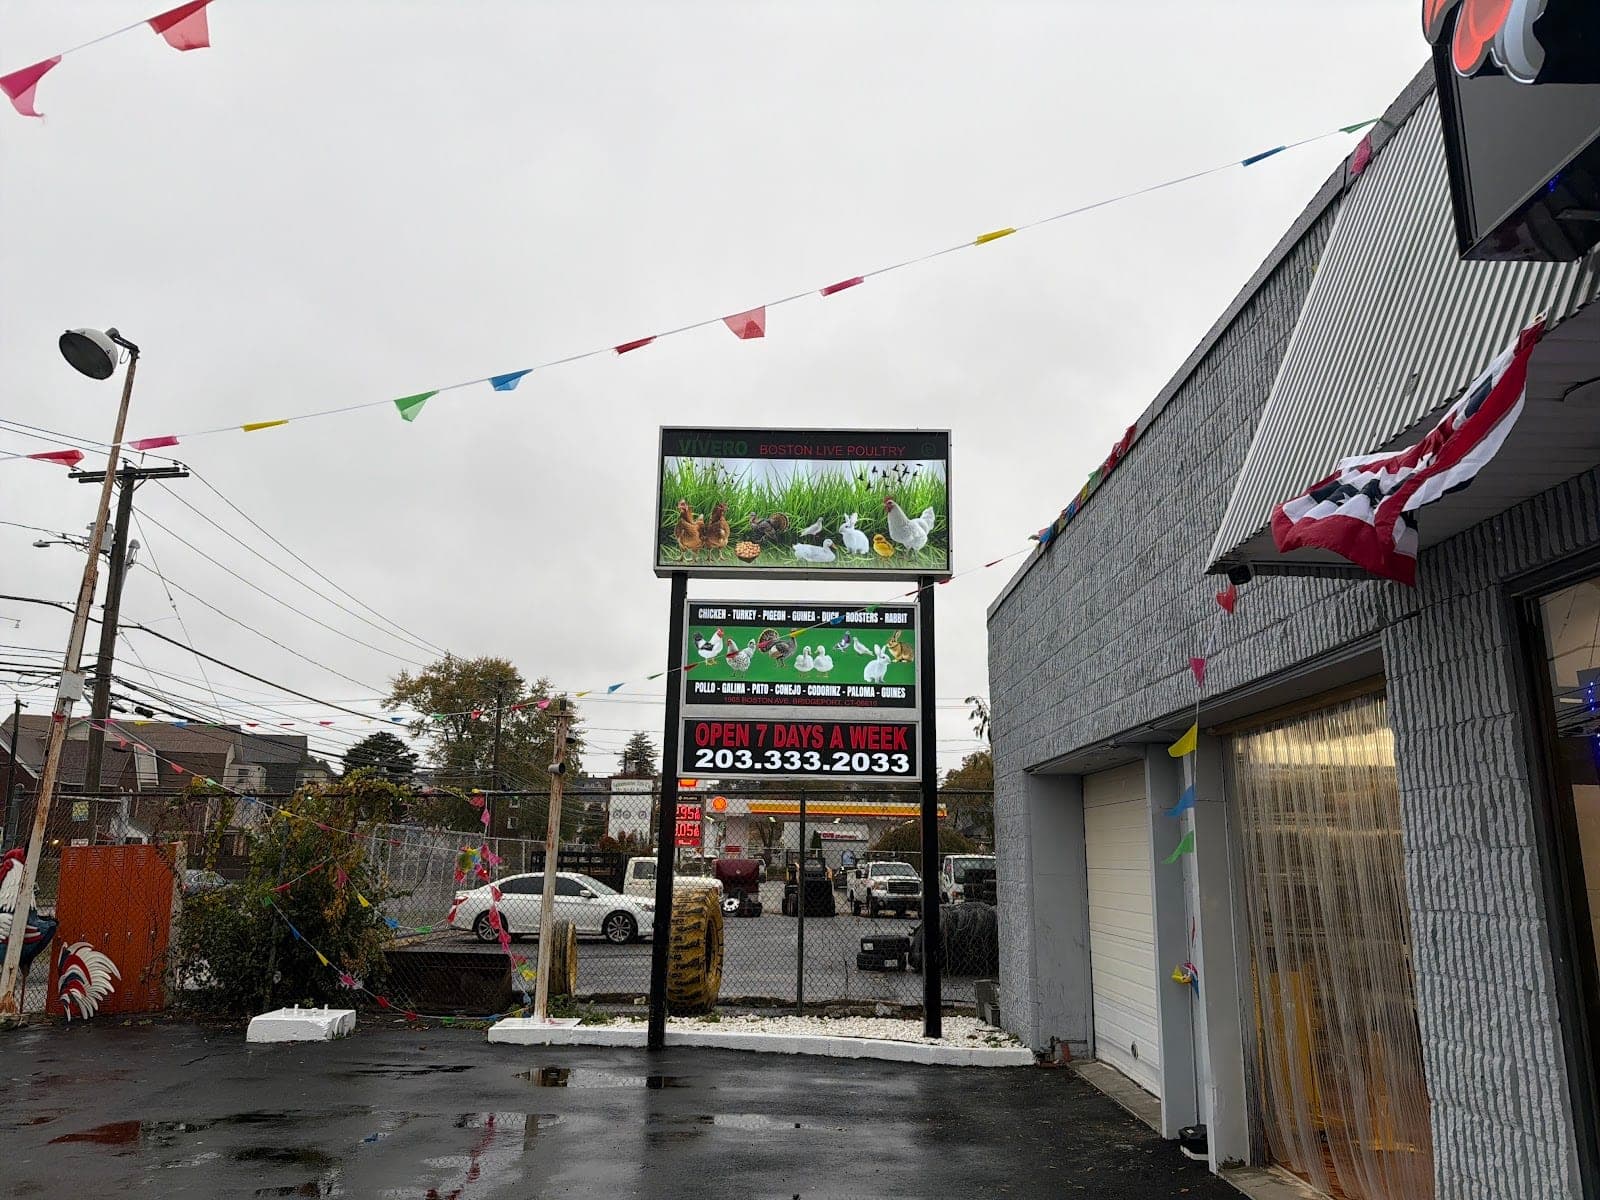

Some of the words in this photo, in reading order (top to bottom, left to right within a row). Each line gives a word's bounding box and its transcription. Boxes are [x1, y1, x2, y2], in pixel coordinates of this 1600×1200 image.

[679, 440, 748, 455] VIVERO
[760, 444, 812, 455] BOSTON
[816, 445, 844, 456] LIVE
[847, 445, 906, 456] POULTRY
[698, 608, 726, 619] CHICKEN
[732, 609, 757, 620] TURKEY
[762, 610, 786, 621] PIGEON
[792, 610, 816, 622] GUINEA
[845, 611, 879, 623] ROOSTERS
[884, 612, 908, 624] RABBIT
[694, 682, 716, 693] POLLO
[751, 683, 769, 694] PATO
[774, 684, 802, 696] CONEJO
[846, 686, 875, 698] PALOMA
[695, 722, 750, 747] OPEN
[755, 723, 769, 748] 7
[773, 724, 824, 748] DAYS
[829, 725, 844, 749] A
[850, 726, 908, 750] WEEK
[694, 748, 910, 773] 203.333.2033
